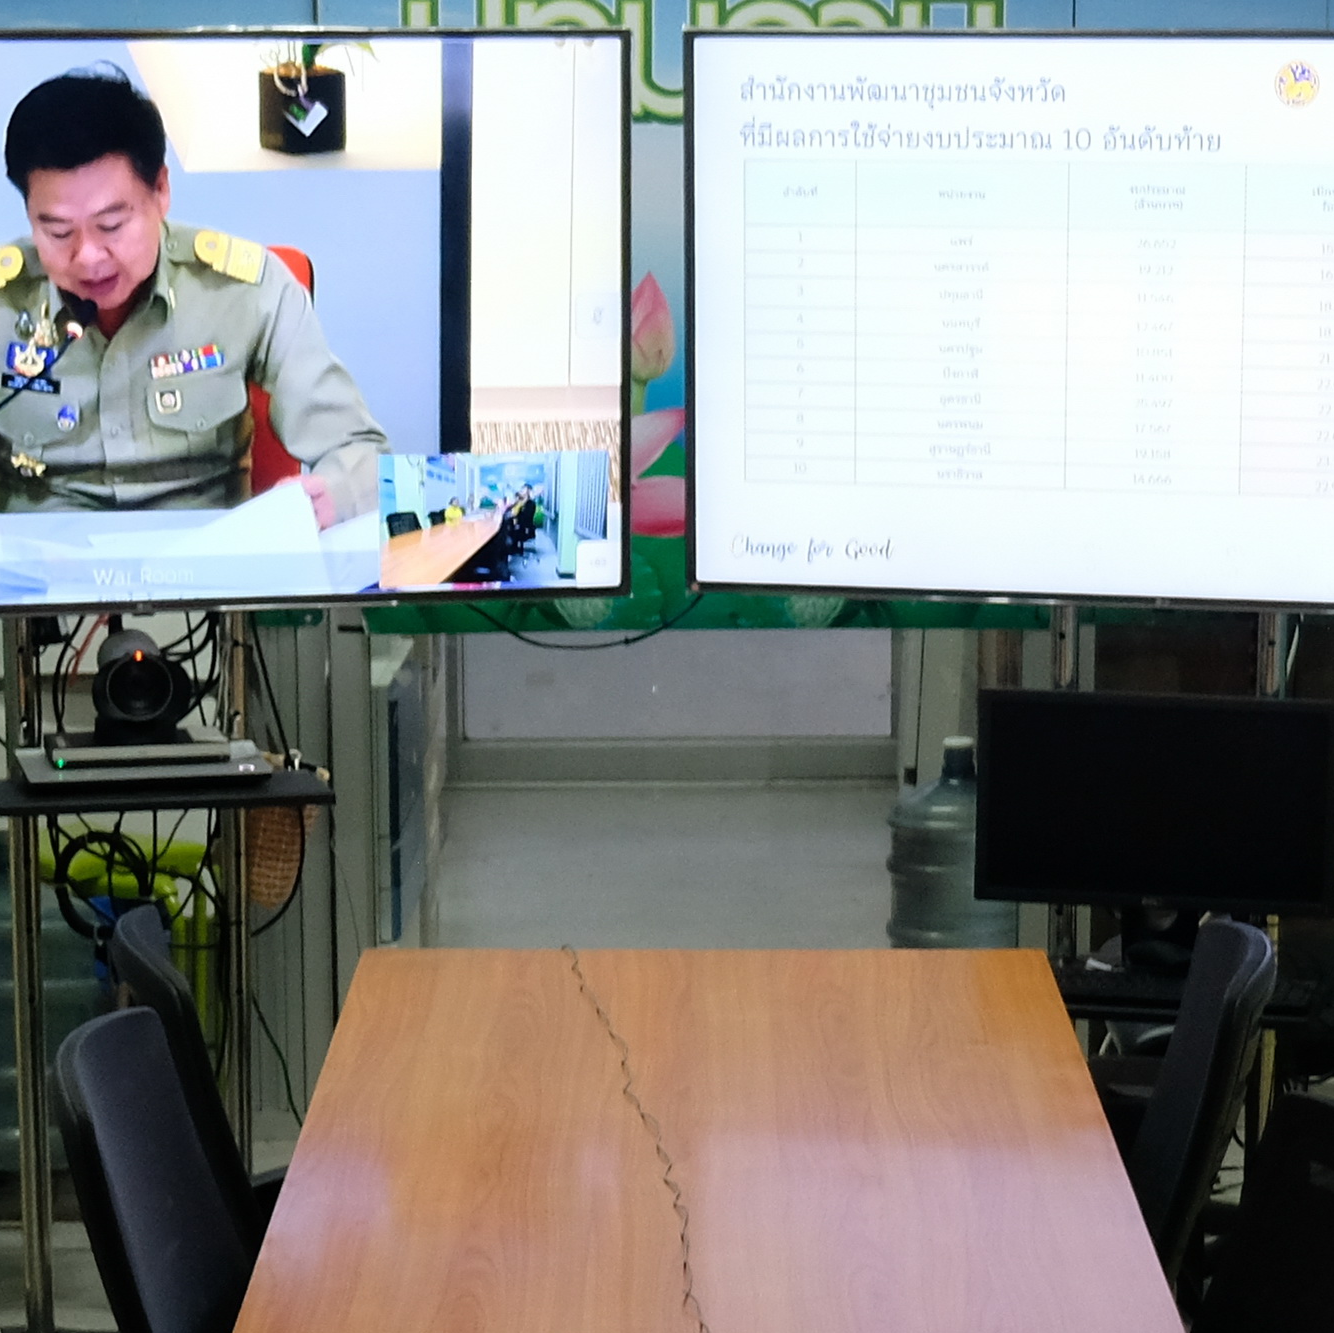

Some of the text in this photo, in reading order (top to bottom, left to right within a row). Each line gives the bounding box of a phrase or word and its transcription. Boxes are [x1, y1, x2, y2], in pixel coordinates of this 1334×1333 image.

[740, 76, 1066, 110] สำนักงานพัฒนาชุมชนจังหวัด
[740, 117, 1221, 152] ที่มีผลการใช้จ่ายงบประมาณ 10 อันดับท้าย
[731, 534, 894, 565] Change for Good
[93, 567, 194, 586] War Room
